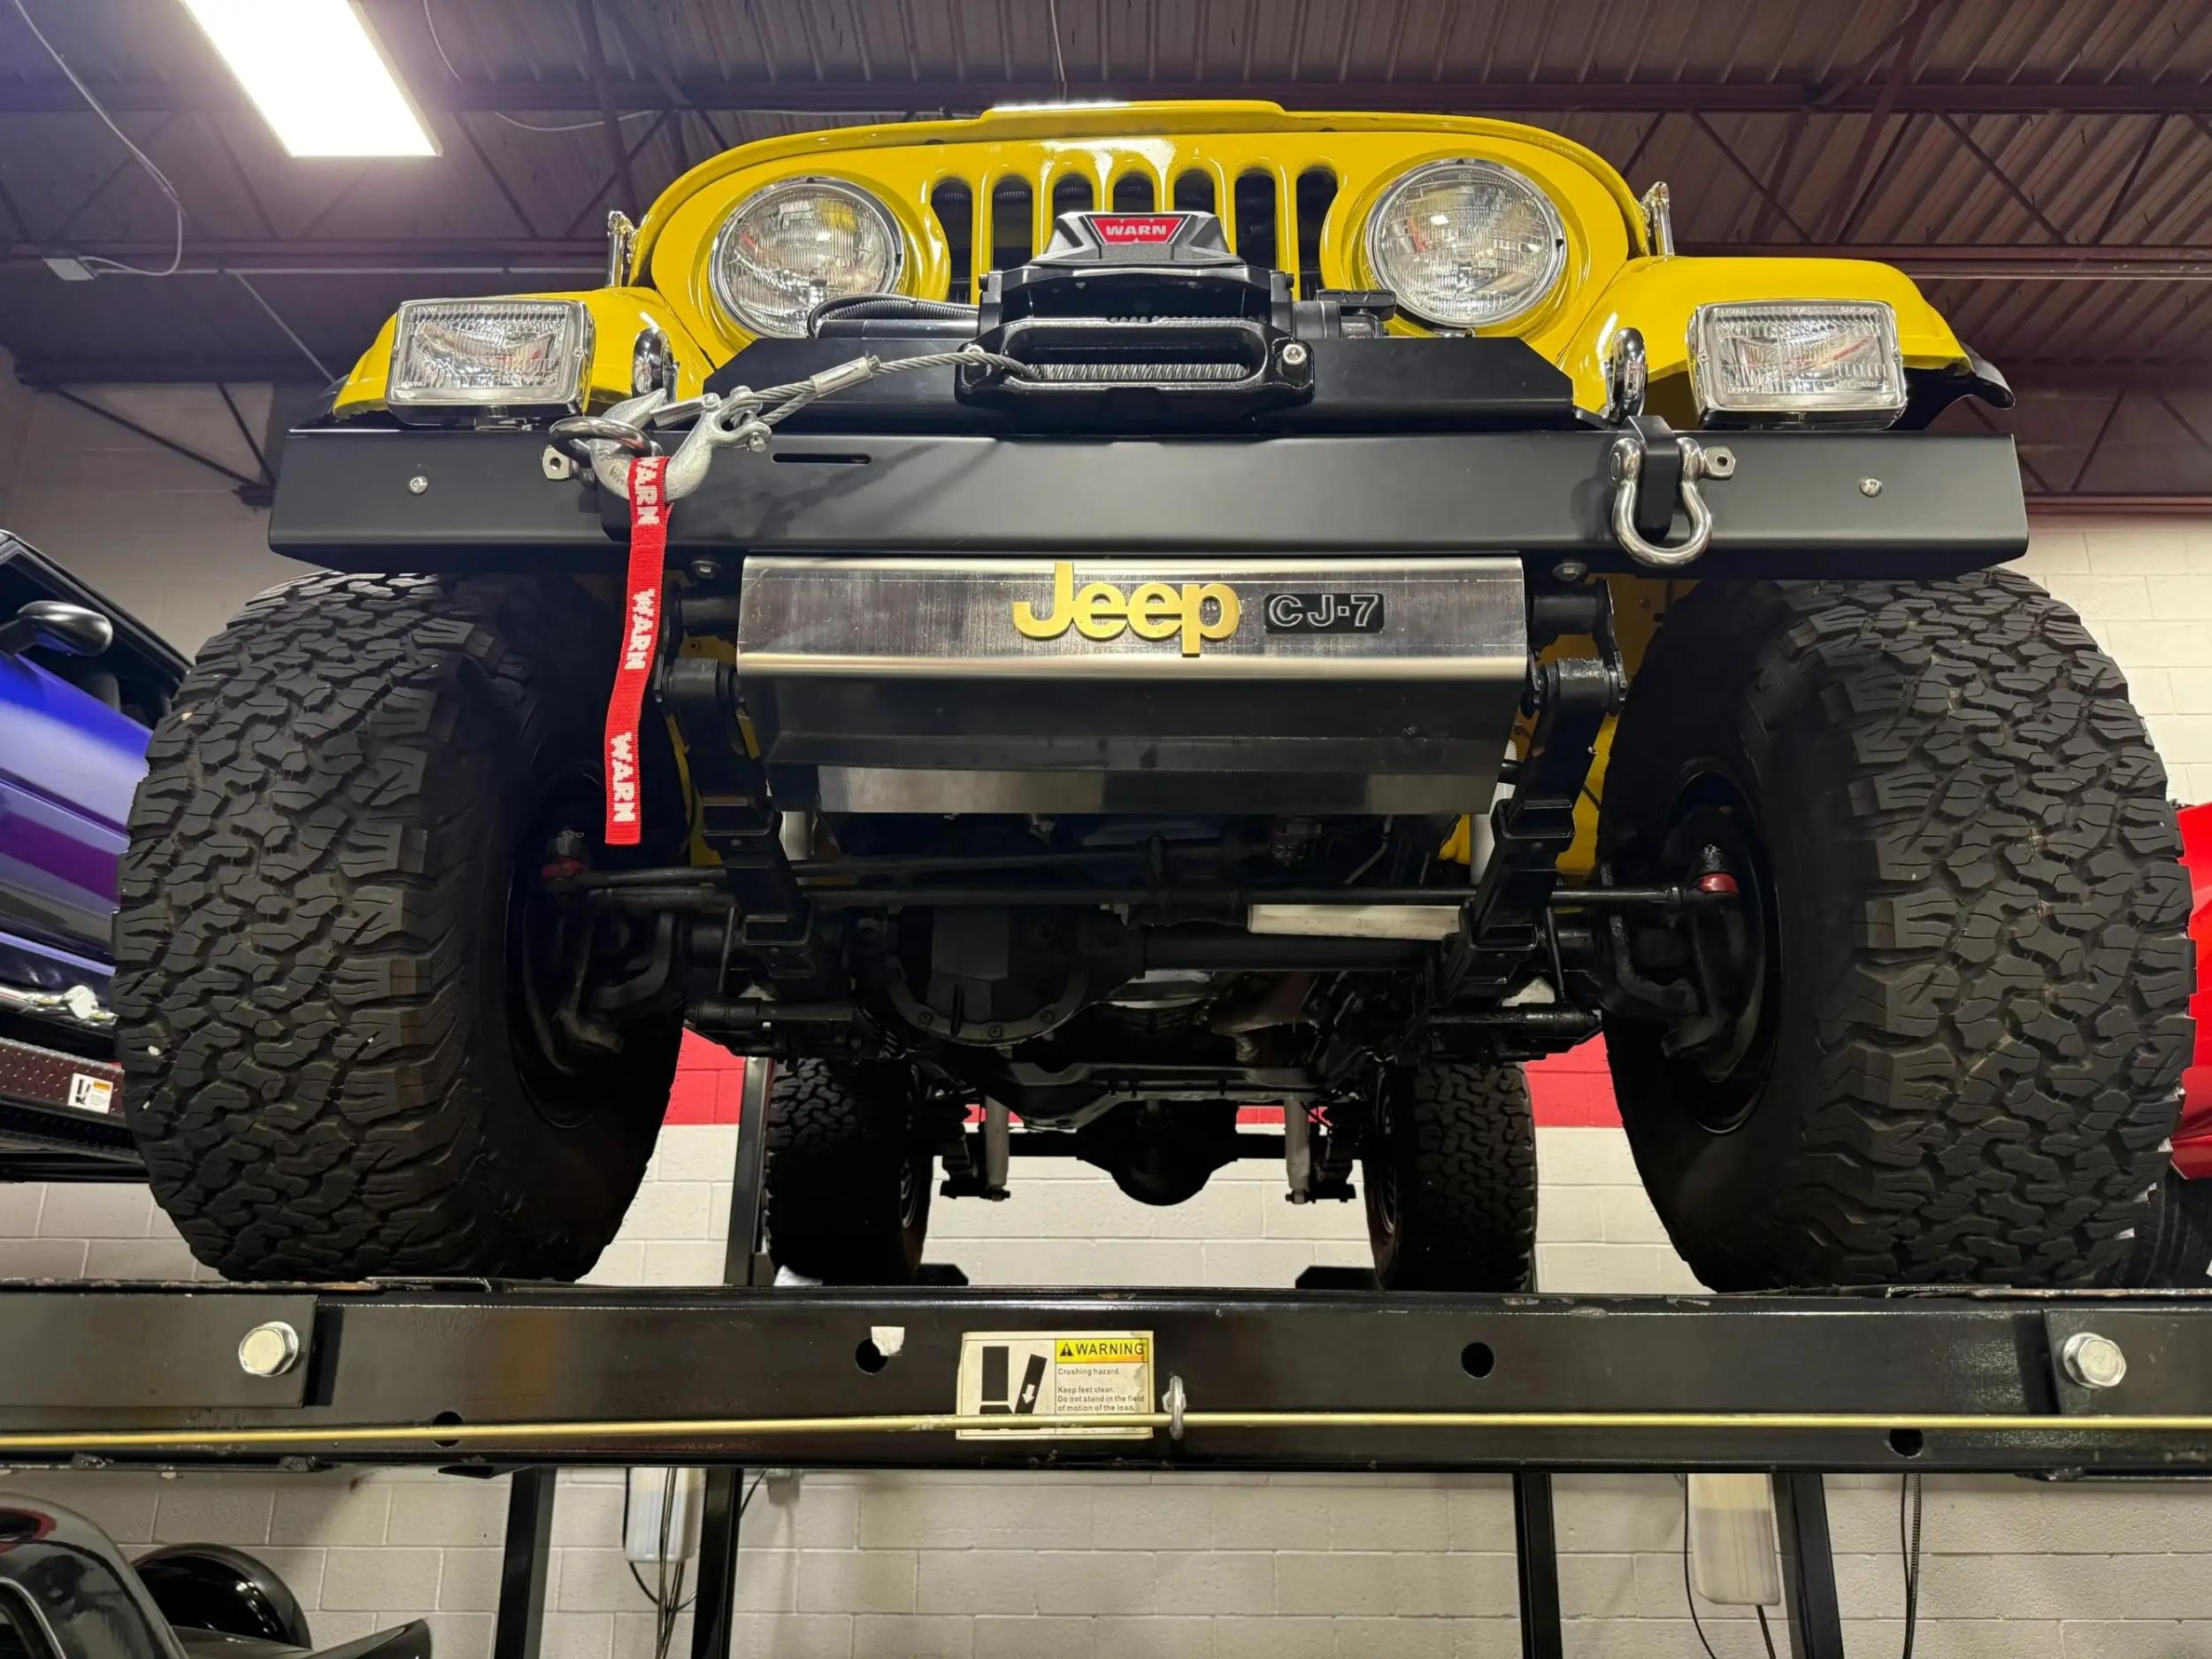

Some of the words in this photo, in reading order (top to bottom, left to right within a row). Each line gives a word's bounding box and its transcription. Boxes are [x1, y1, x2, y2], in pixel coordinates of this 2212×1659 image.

[1105, 225, 1167, 236] WARN
[623, 588, 656, 671] WARN
[1012, 561, 1241, 658] Jeep
[1269, 594, 1379, 627] CJ-7
[611, 731, 636, 824] WARN
[1057, 1368, 1092, 1377] Crushing
[1076, 1343, 1144, 1356] WARNING
